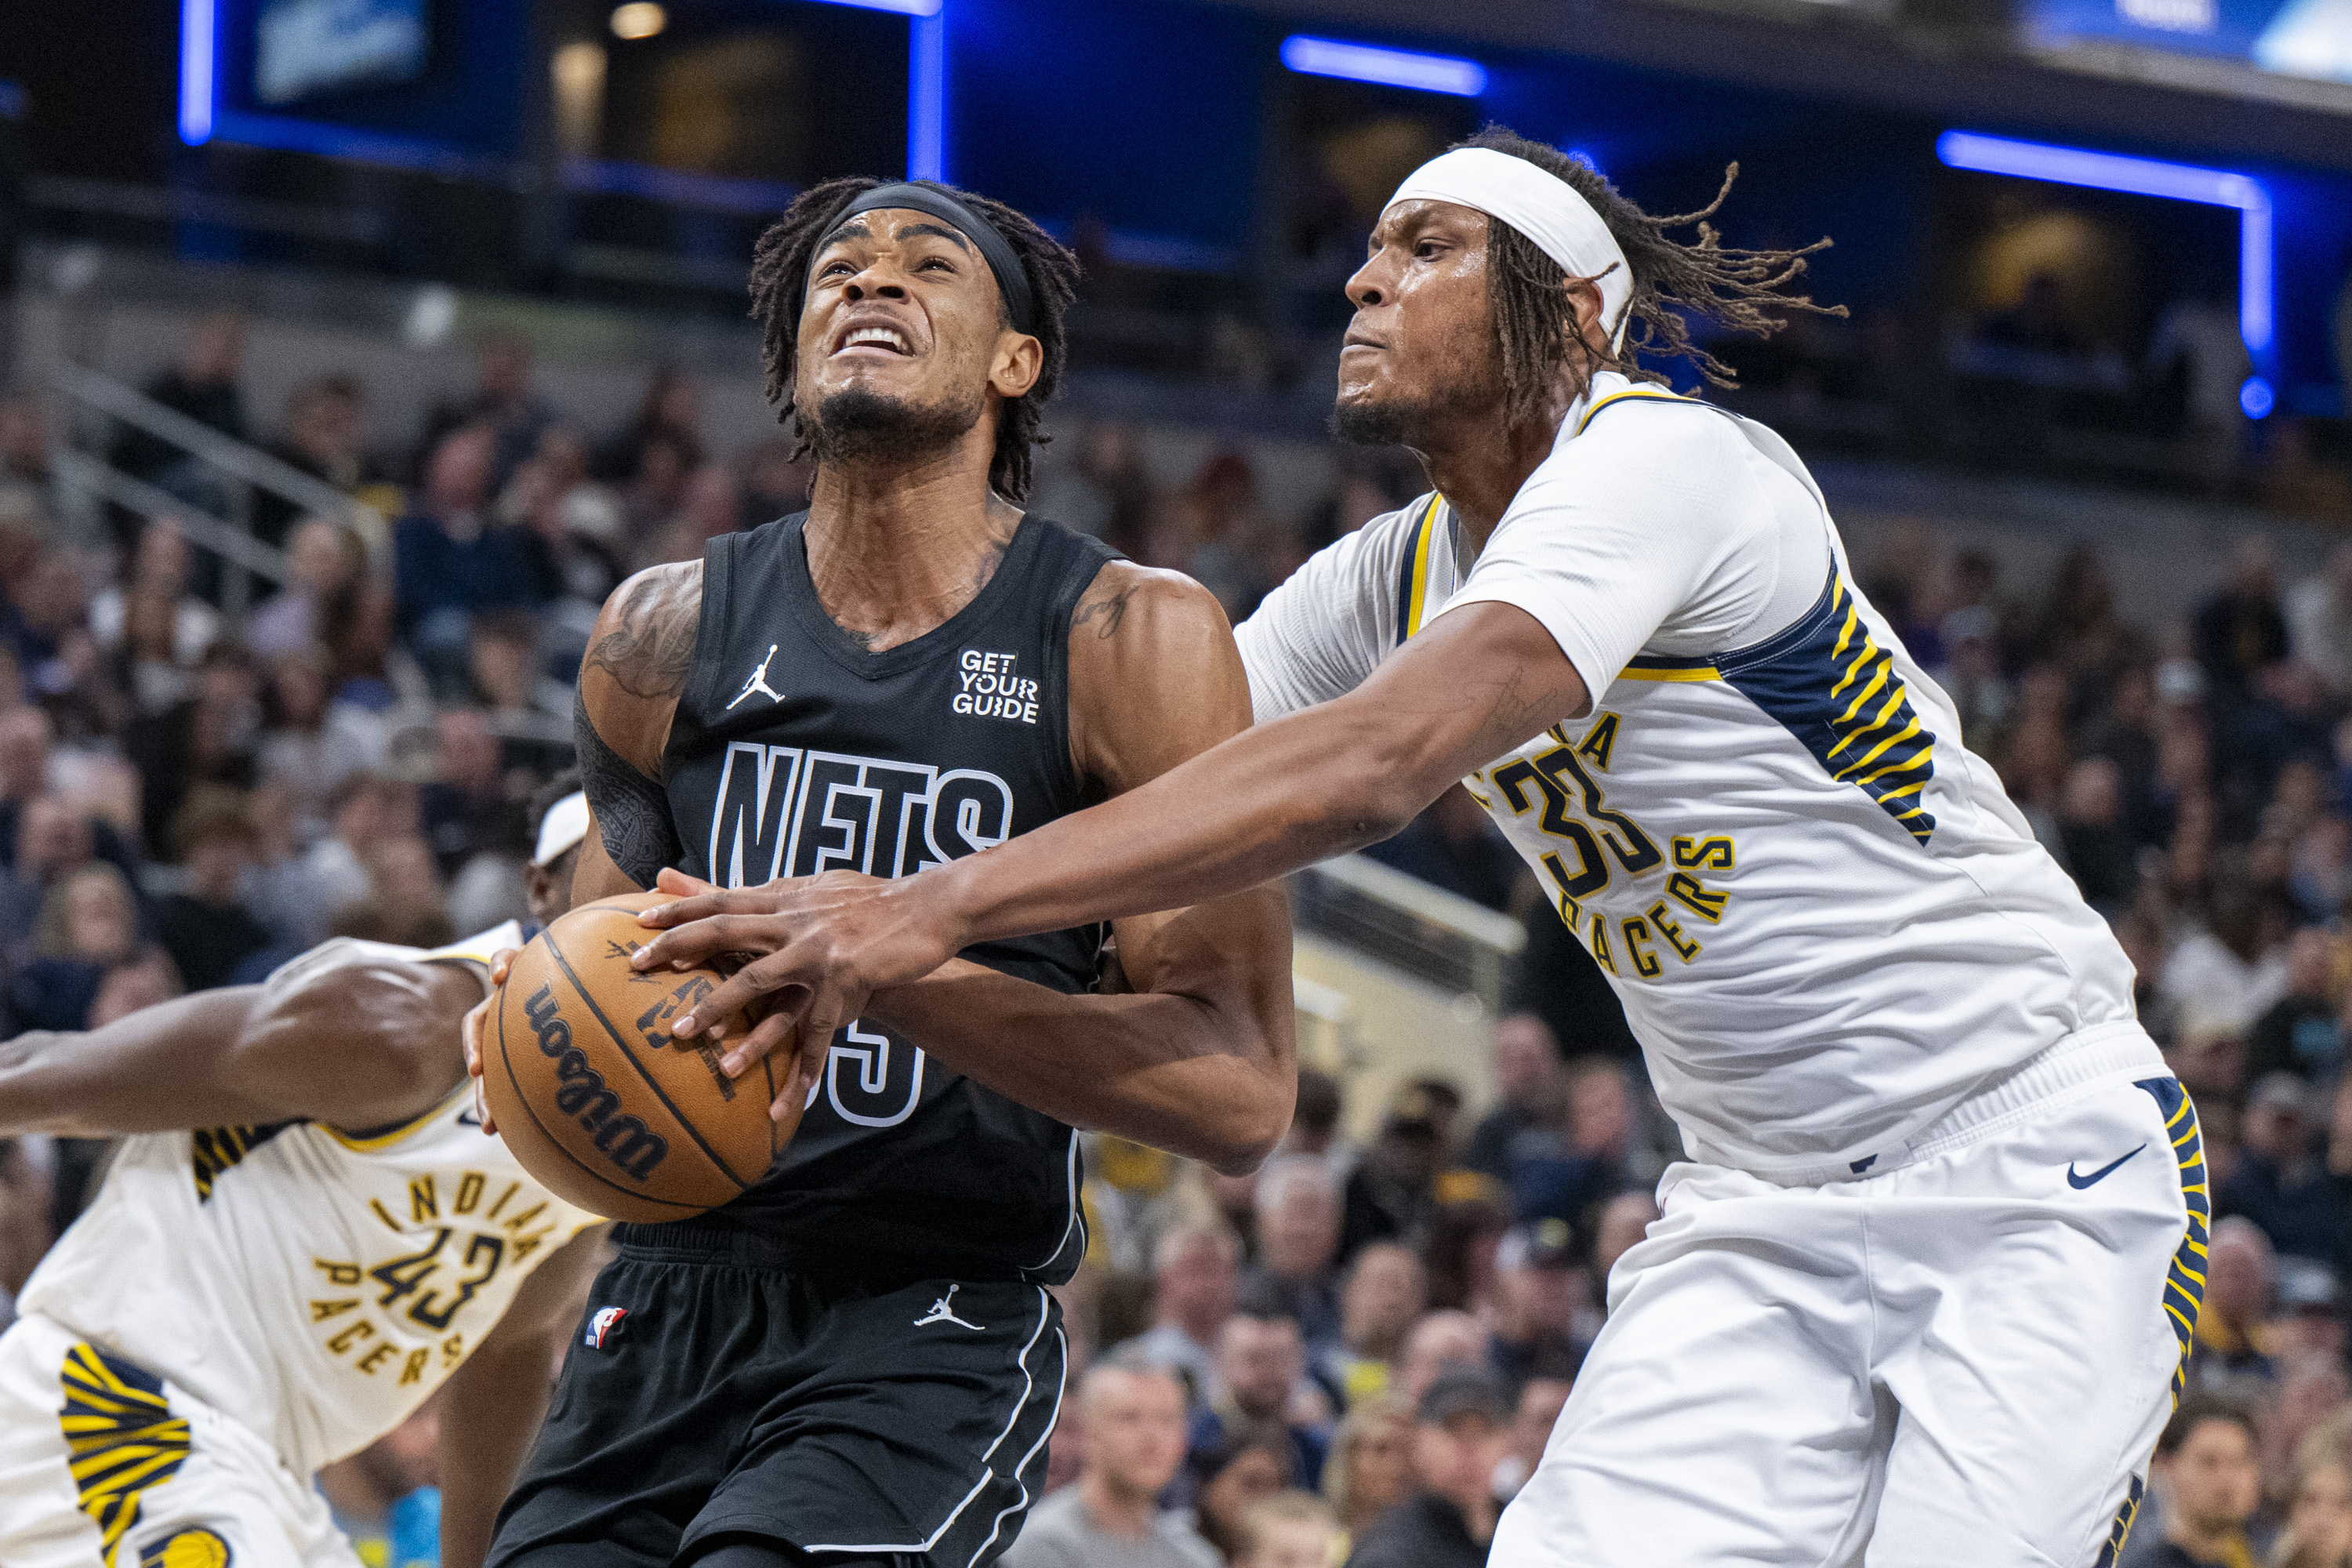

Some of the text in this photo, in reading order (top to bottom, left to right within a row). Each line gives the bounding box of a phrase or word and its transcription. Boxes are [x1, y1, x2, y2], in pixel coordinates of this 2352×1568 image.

[960, 649, 1016, 674] GET
[959, 670, 1039, 702] YOUR
[952, 693, 1040, 724] GUIDE
[1490, 742, 1665, 902] 33
[366, 1225, 504, 1332] 43
